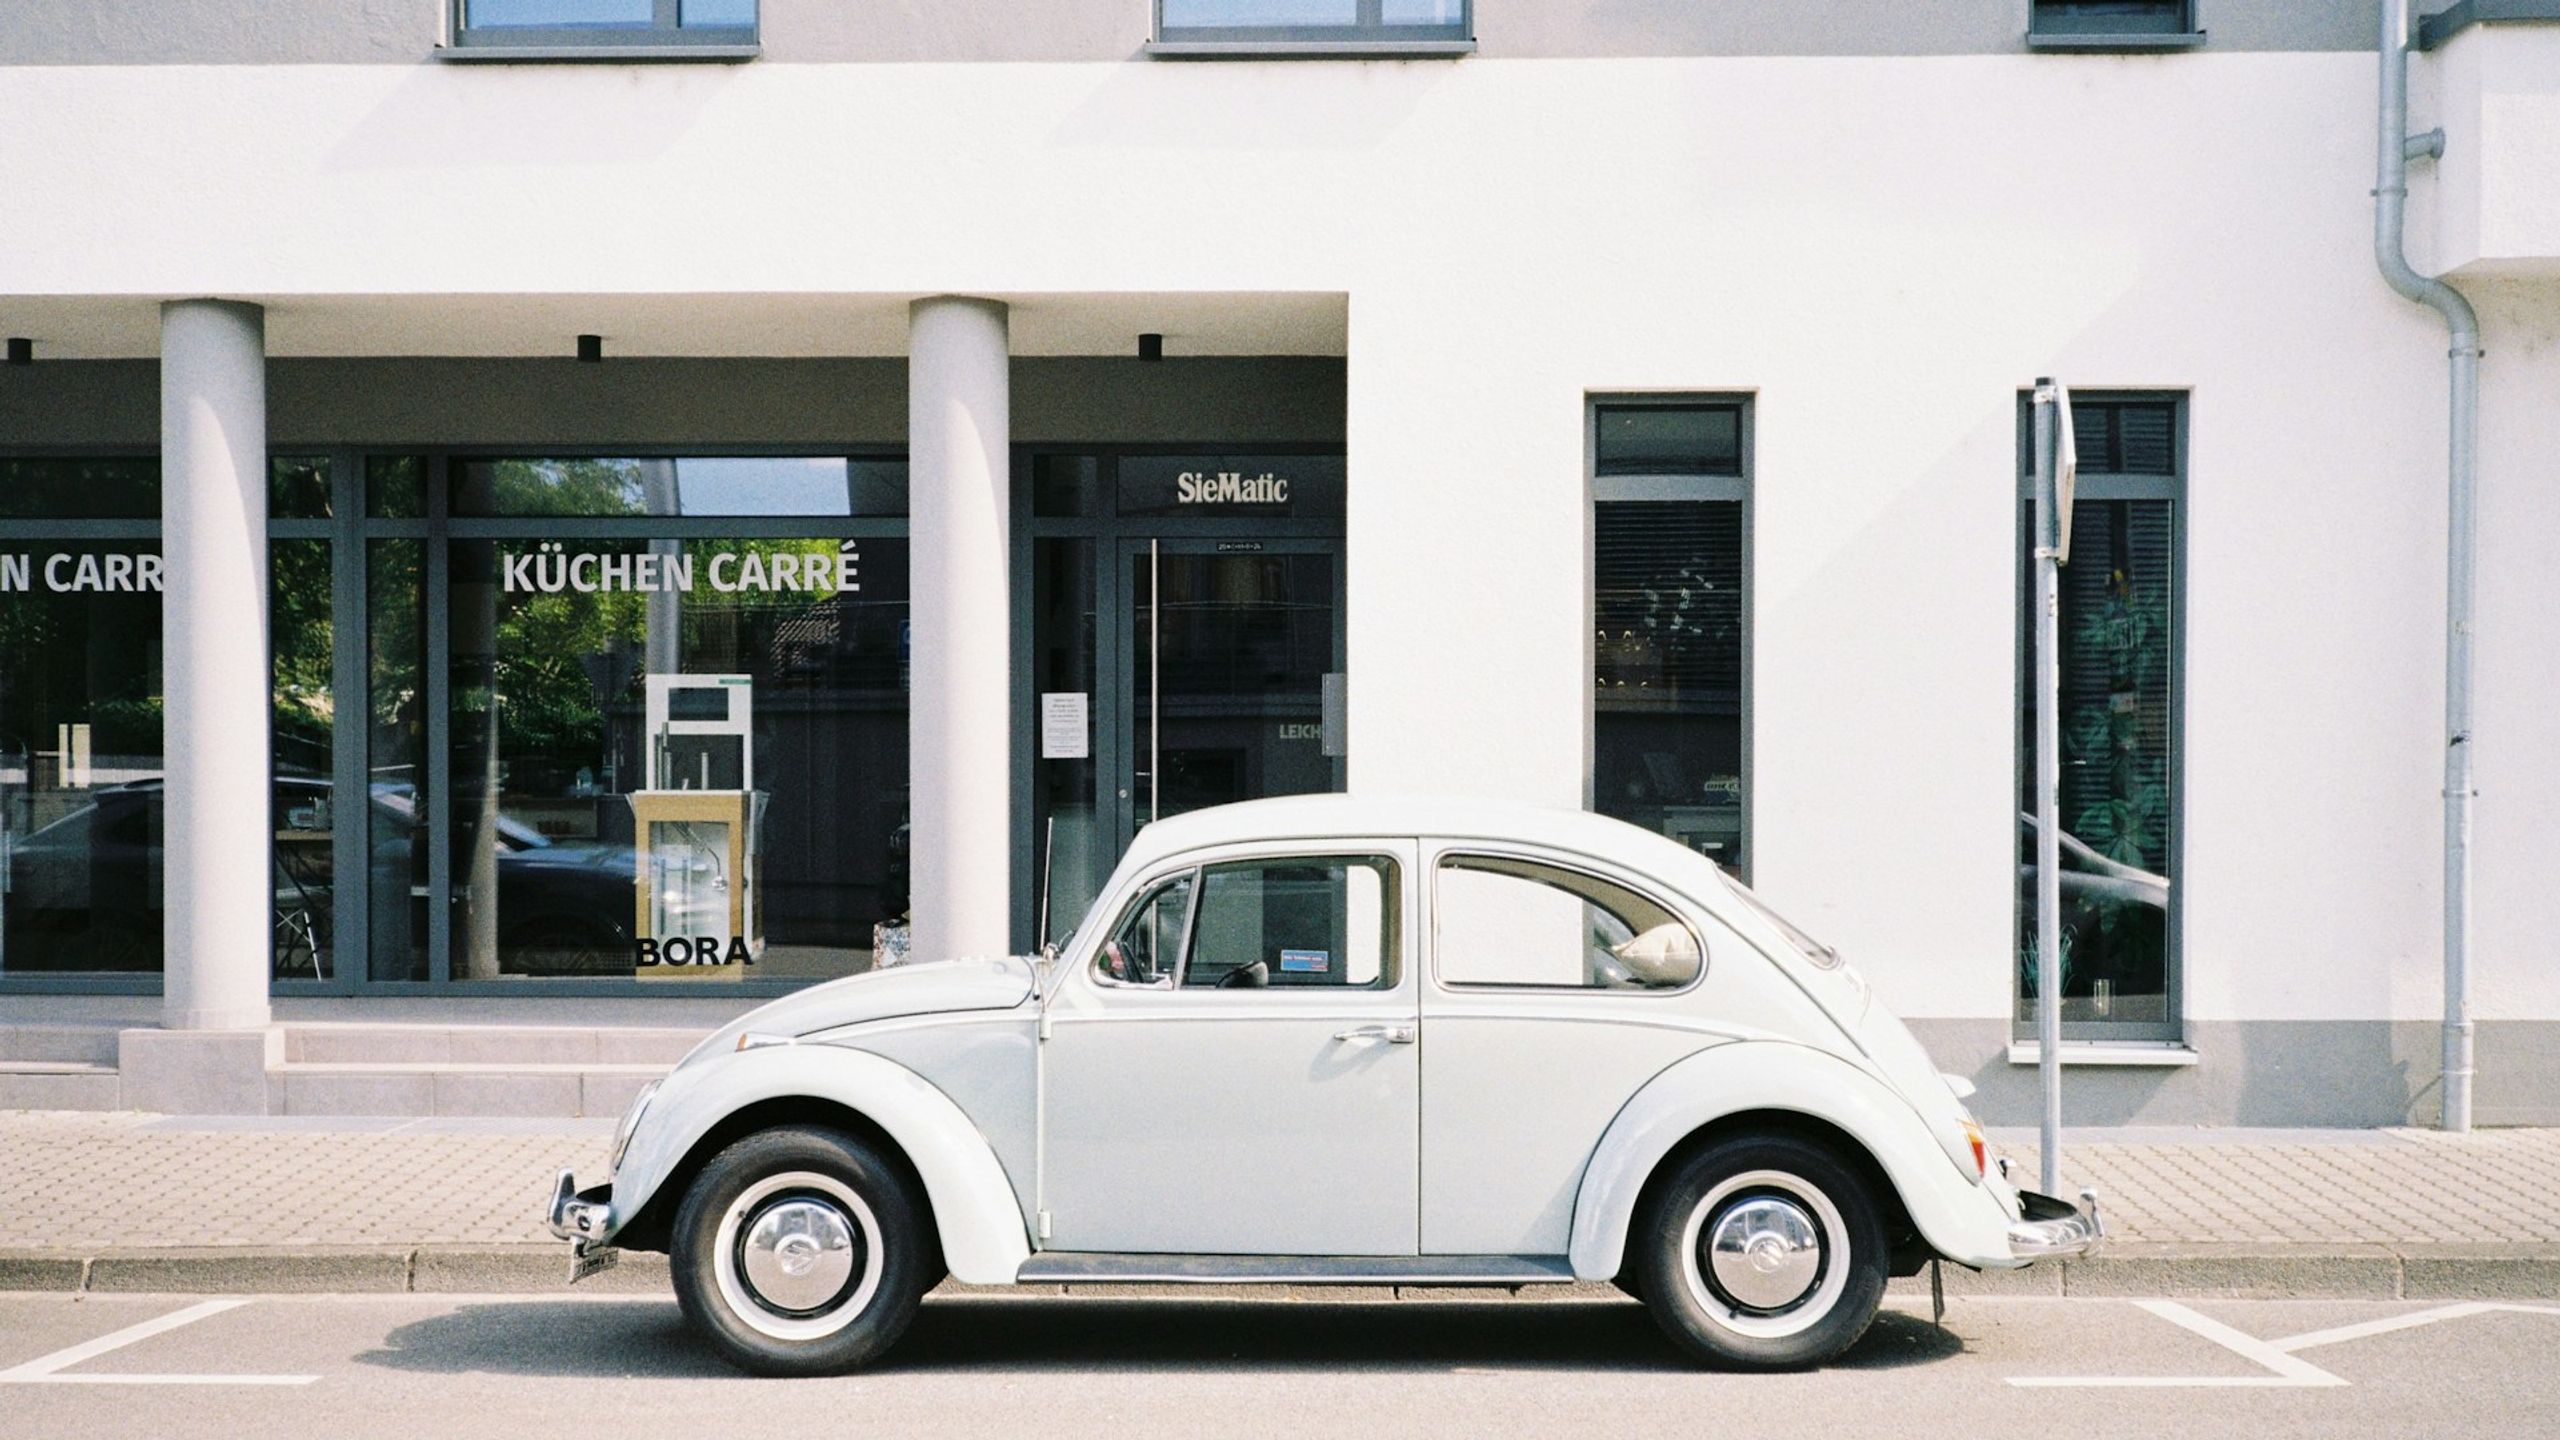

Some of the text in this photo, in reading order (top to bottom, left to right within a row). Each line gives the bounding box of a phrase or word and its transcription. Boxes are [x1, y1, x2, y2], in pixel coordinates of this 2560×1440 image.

[1178, 472, 1288, 502] SieMatic
[504, 539, 860, 592] KÜCHEN CARRÉ
[636, 936, 754, 967] BORA
